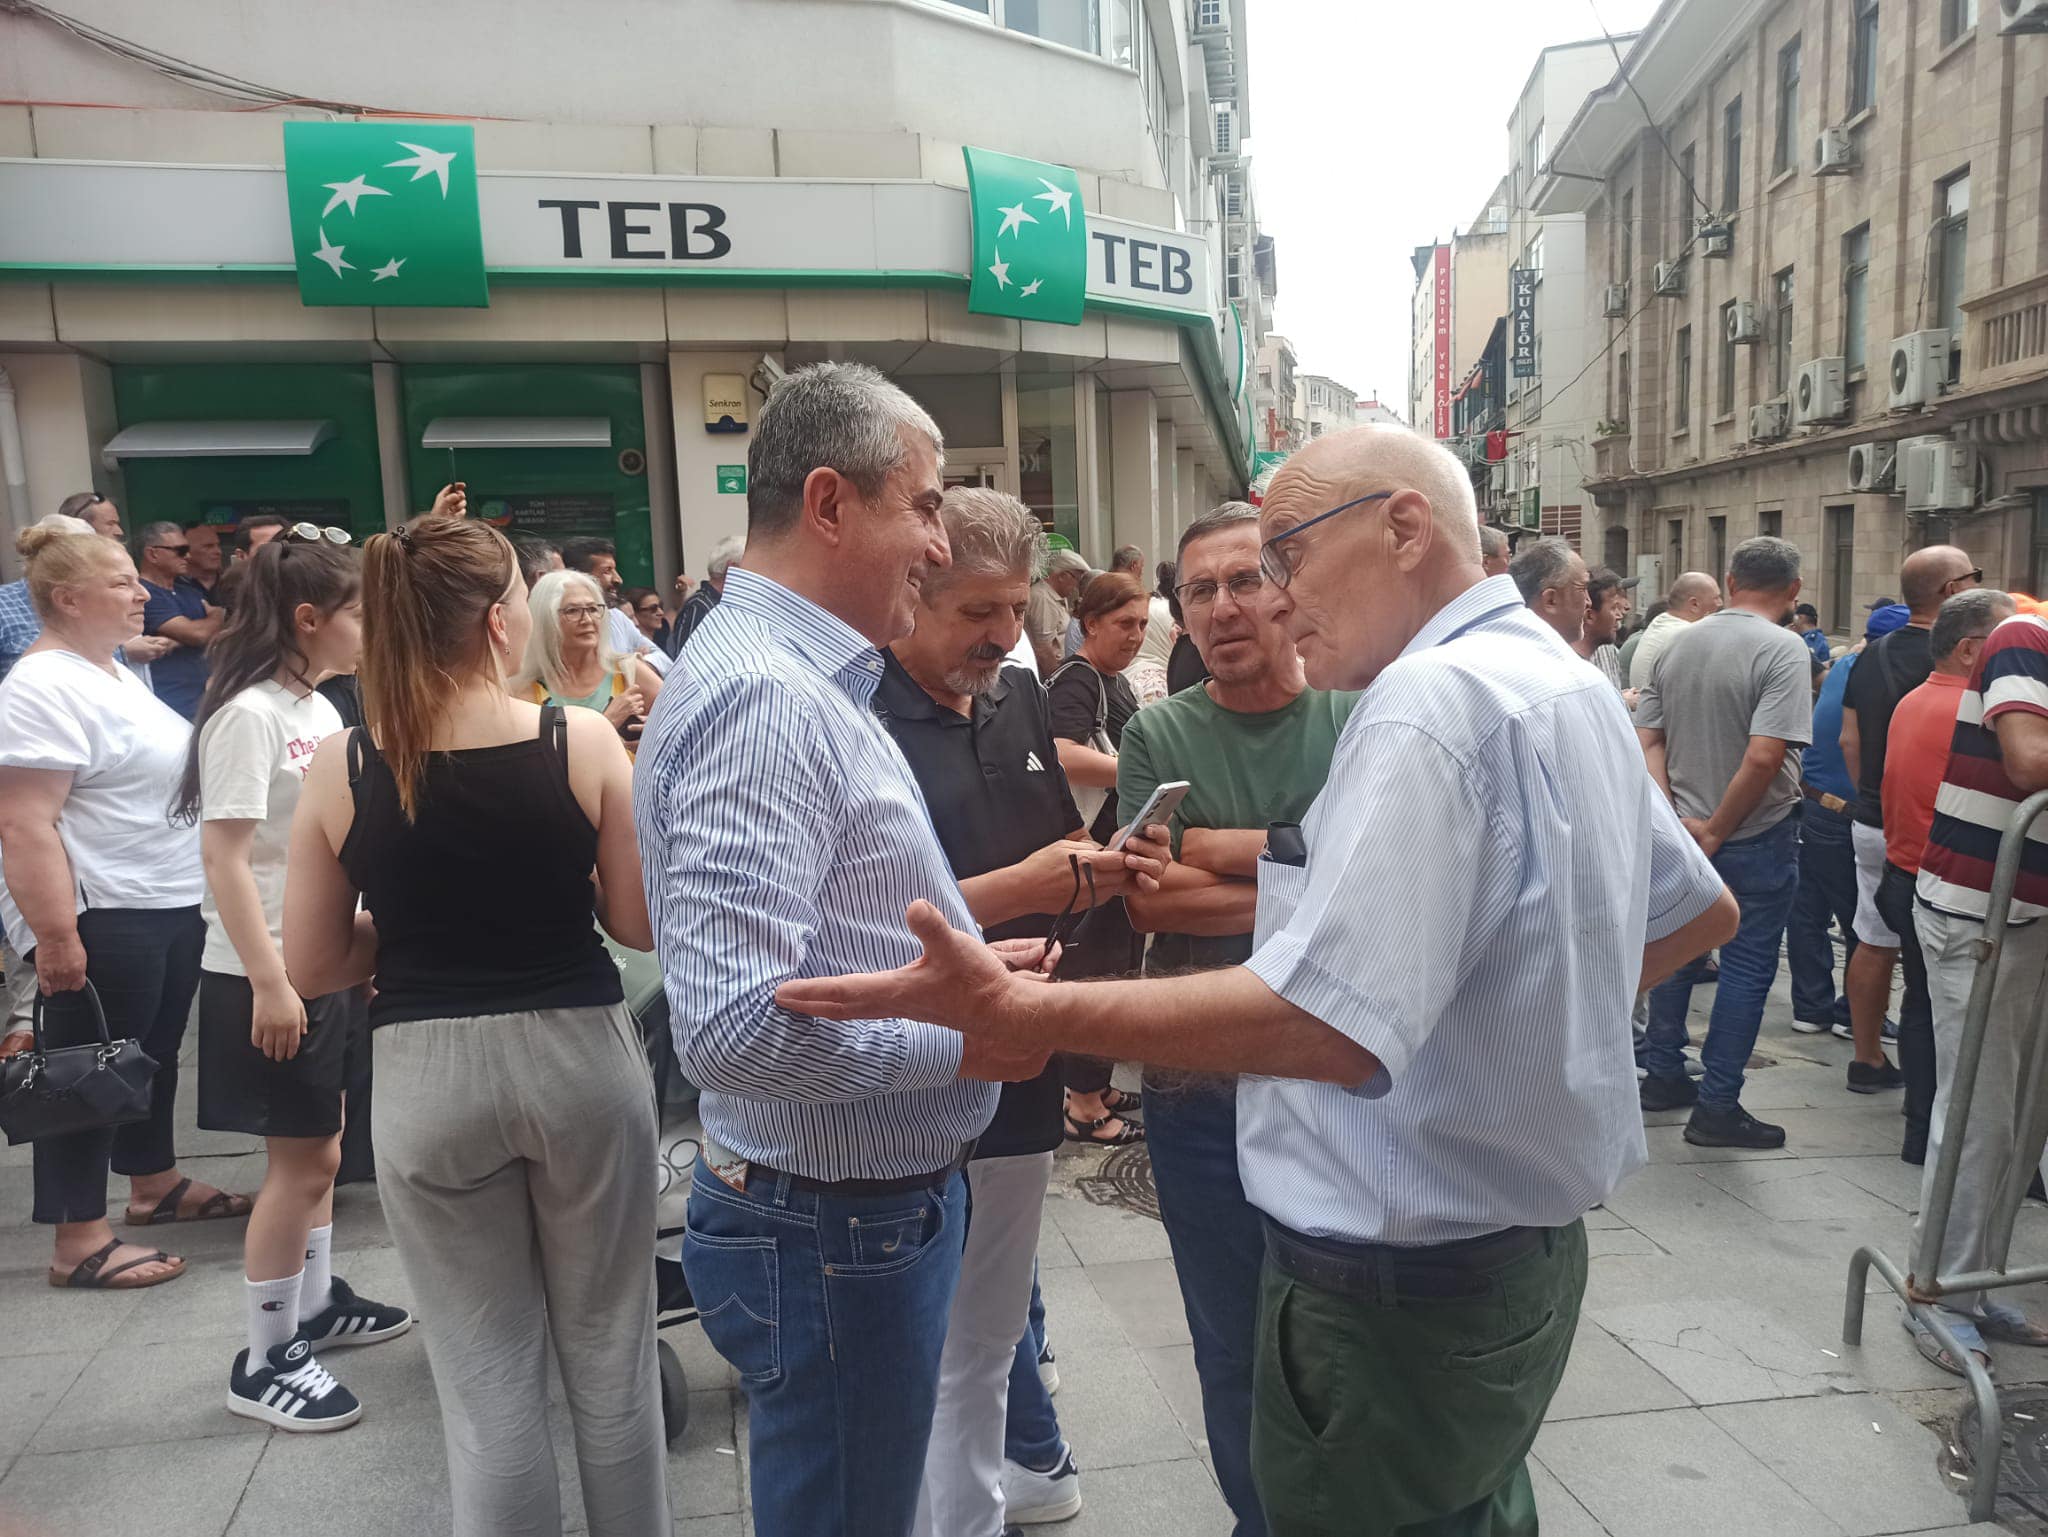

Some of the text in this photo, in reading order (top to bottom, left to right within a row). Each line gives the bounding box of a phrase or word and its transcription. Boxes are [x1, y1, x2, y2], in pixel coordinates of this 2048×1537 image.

[538, 199, 732, 260] TEB
[1092, 231, 1193, 295] TEB
[1517, 284, 1532, 358] KUAFÖR
[709, 399, 742, 408] Senkron
